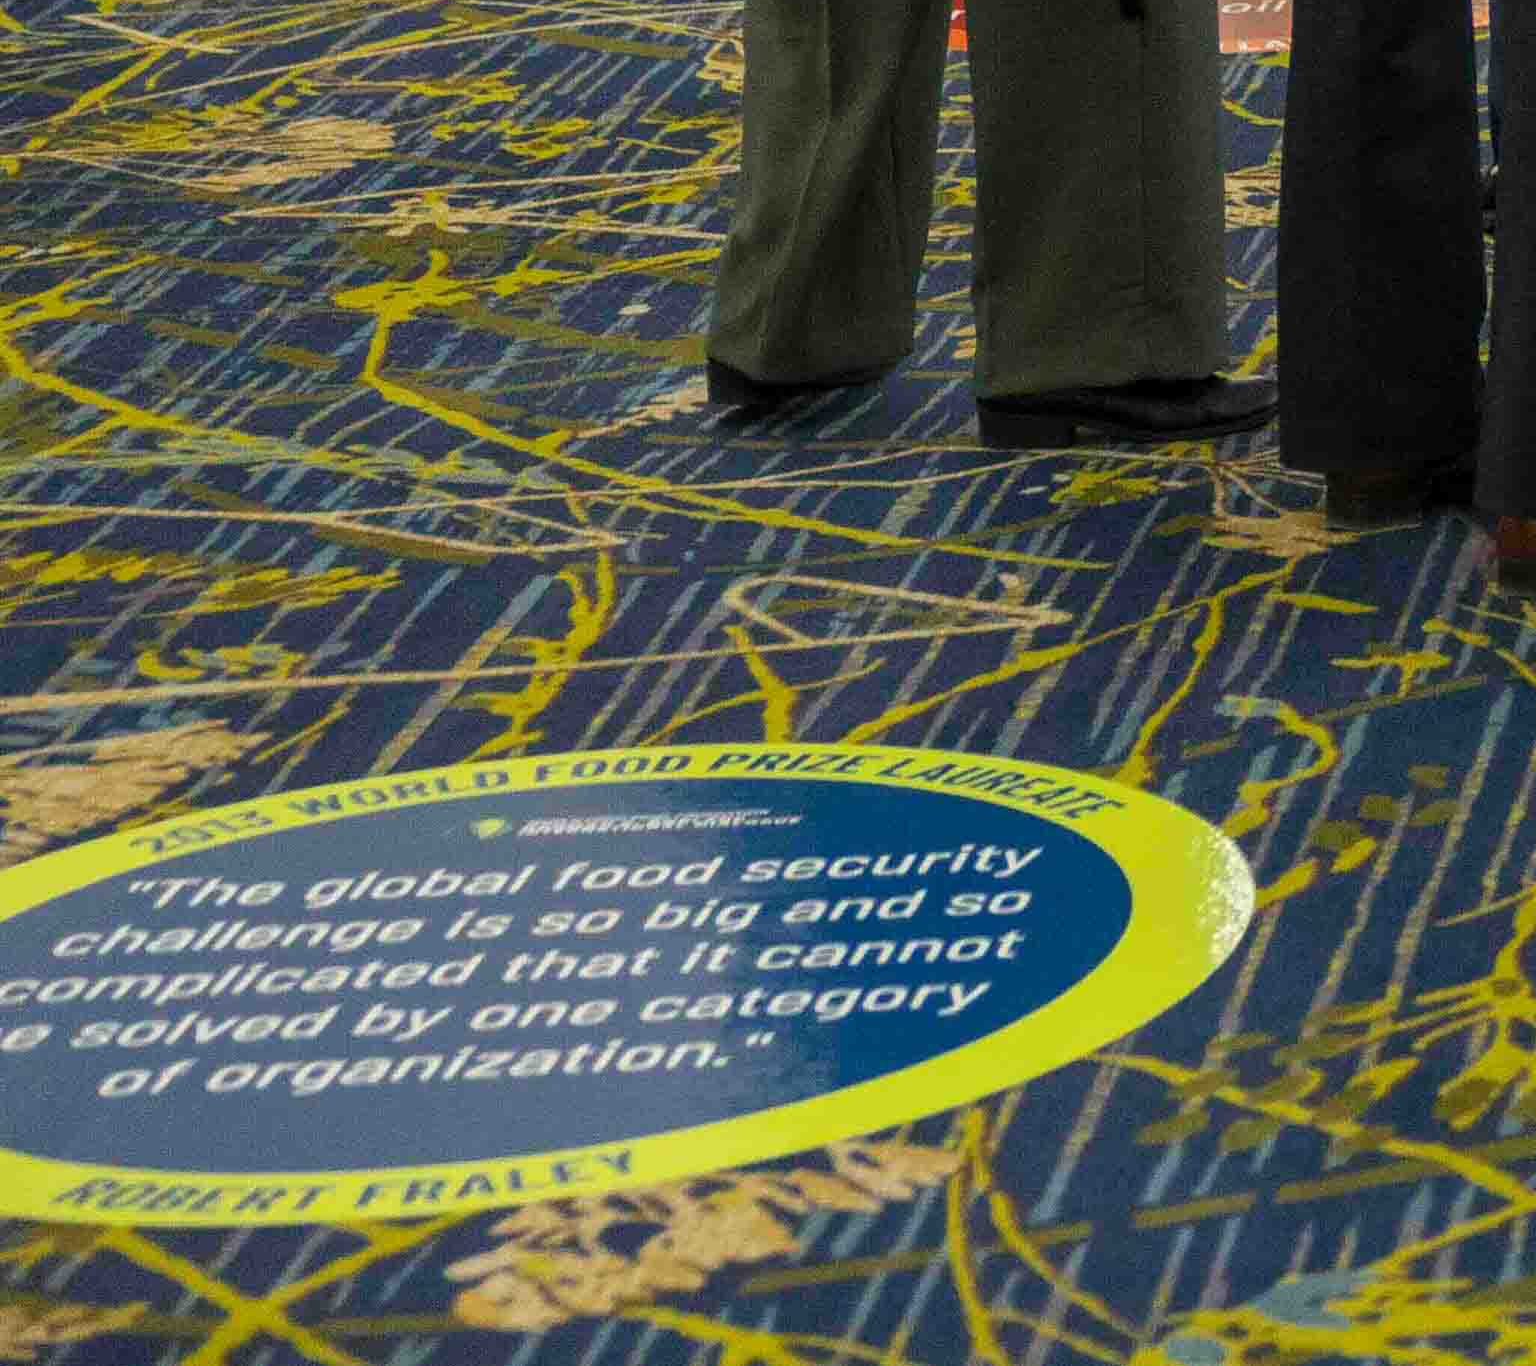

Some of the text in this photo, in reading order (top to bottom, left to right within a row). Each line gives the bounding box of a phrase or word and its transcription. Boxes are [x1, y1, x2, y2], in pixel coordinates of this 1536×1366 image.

[130, 751, 1127, 855] 2013 WORLD FOOD PRIZE LAUREATE
[128, 843, 1043, 909] "The global food security
[52, 888, 1033, 958] challenge is so big and so
[0, 928, 1026, 1006] complicated that it cannot
[0, 980, 992, 1052] e solved by one category
[98, 1057, 198, 1097] of
[50, 1148, 634, 1213] ROBERT FRALEY
